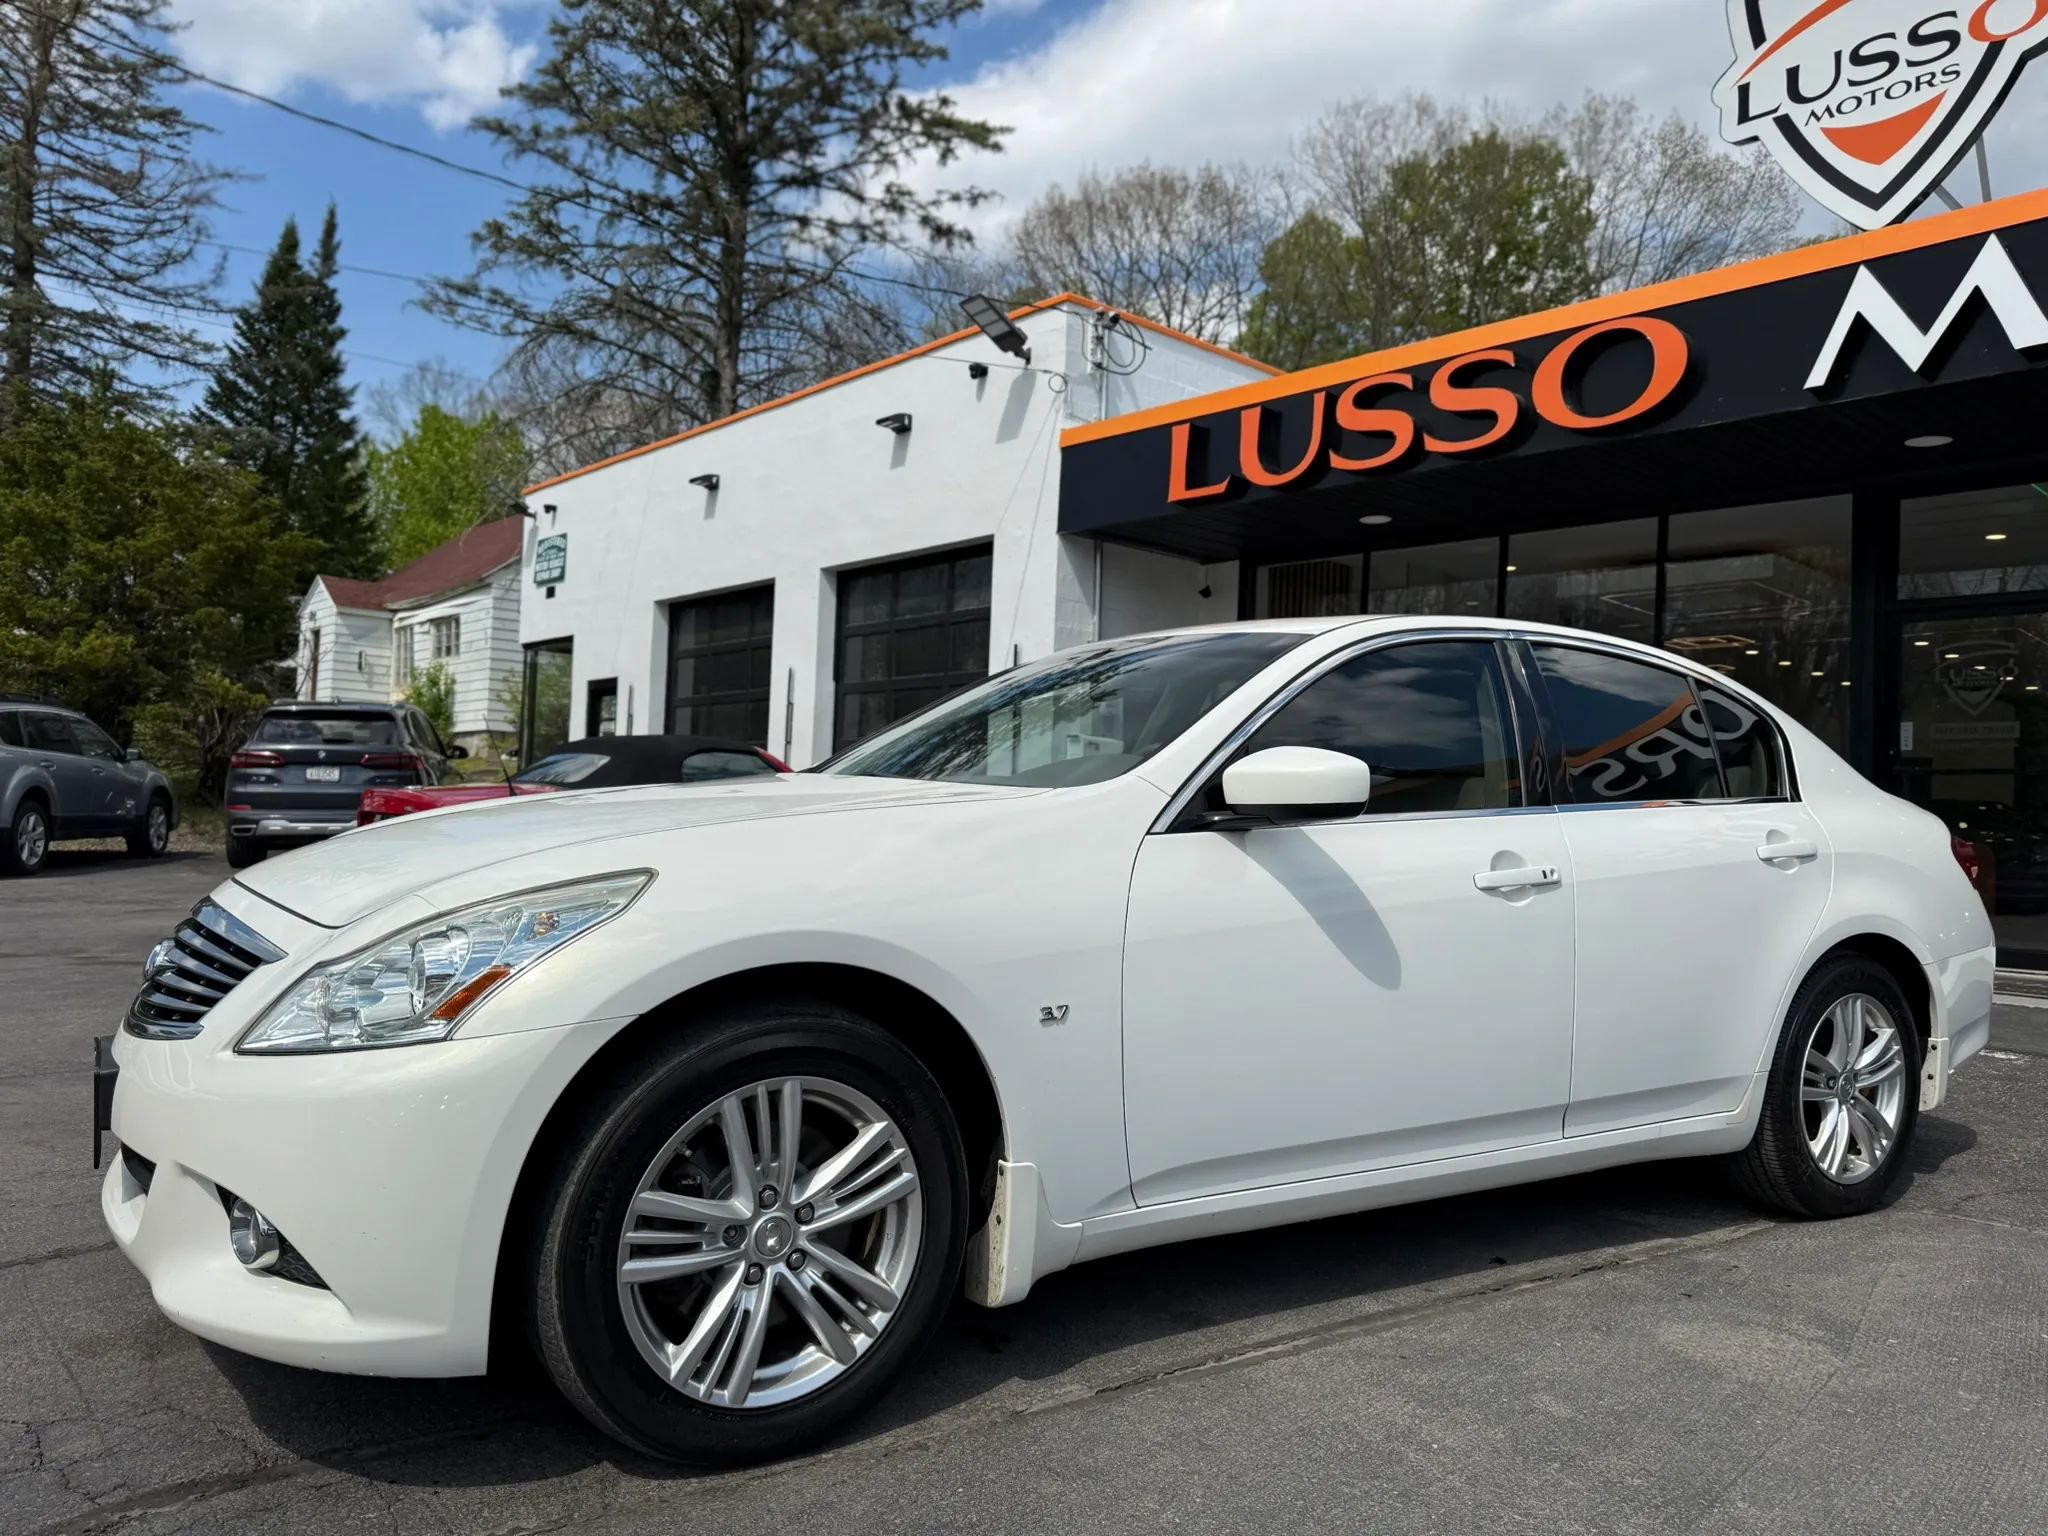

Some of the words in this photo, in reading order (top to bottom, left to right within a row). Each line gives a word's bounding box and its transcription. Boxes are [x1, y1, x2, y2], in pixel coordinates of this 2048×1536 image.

[1736, 0, 2048, 126] LUSSO
[1803, 62, 1961, 127] MOTORS
[1168, 317, 1688, 503] LUSSO
